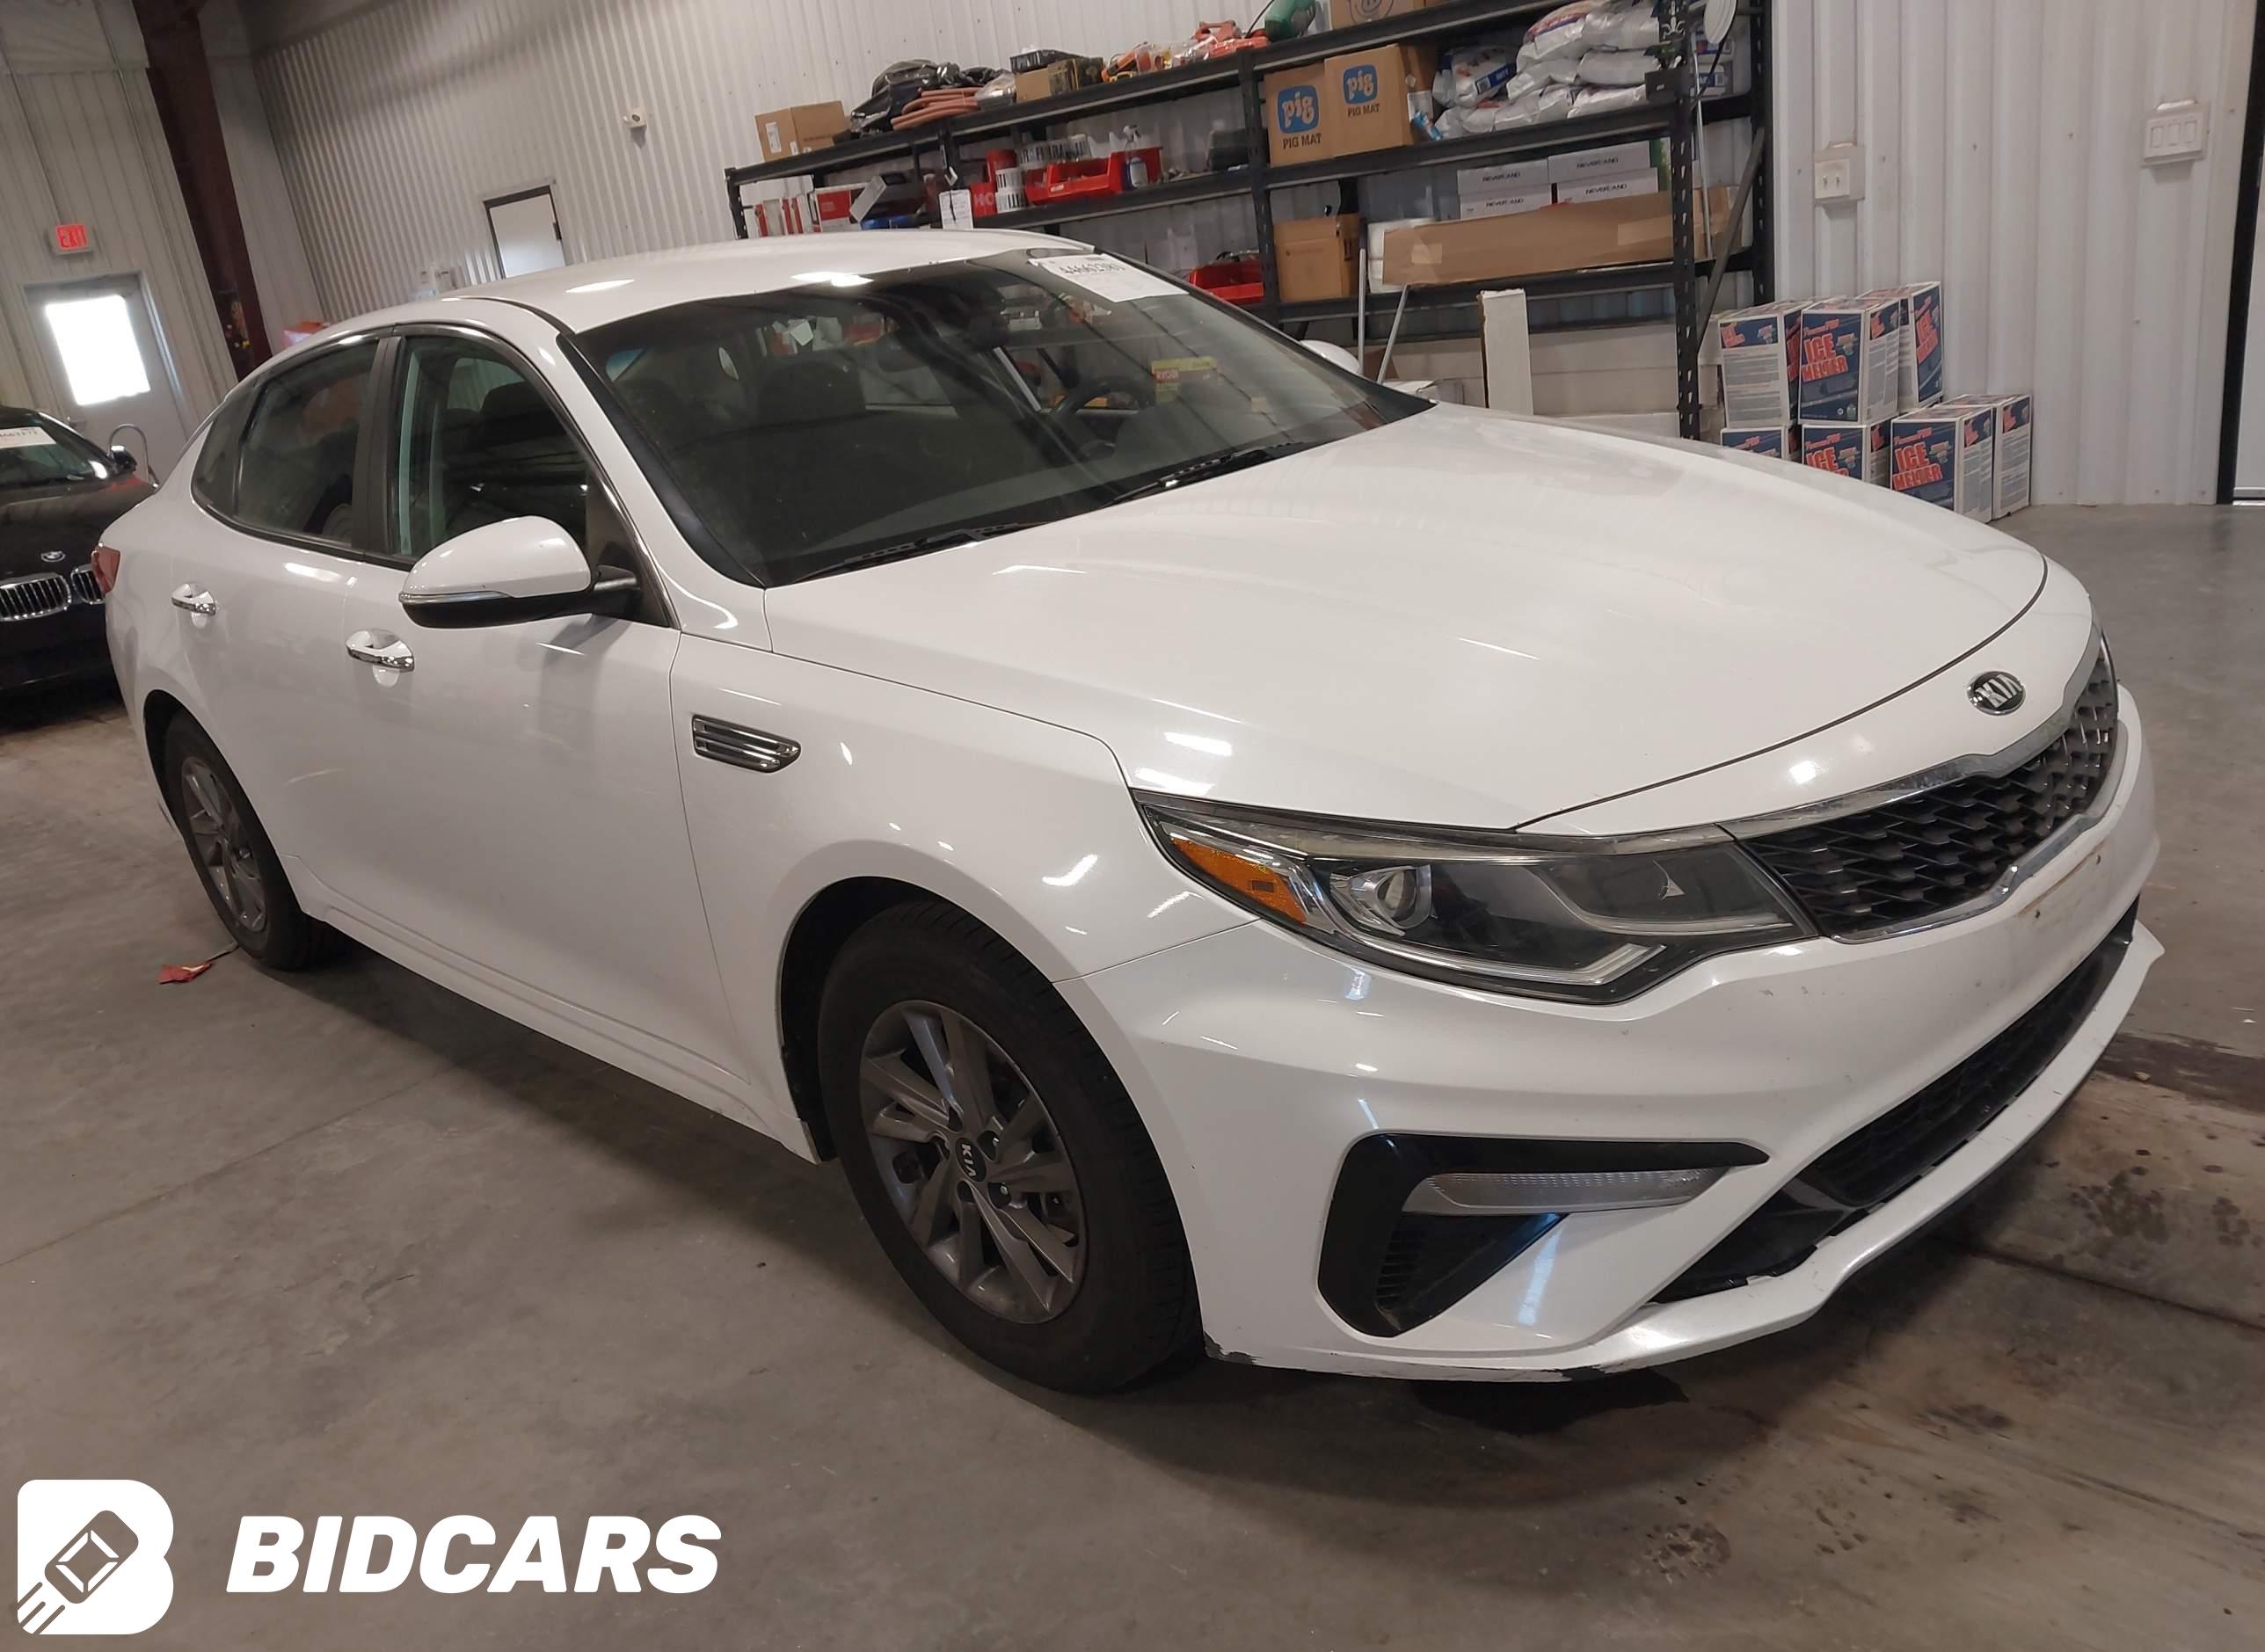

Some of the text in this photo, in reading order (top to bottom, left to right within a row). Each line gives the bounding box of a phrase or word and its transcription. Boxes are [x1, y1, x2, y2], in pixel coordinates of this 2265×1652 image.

[1346, 70, 1373, 100] pig
[1282, 91, 1315, 127] pig
[1347, 104, 1380, 117] PIG MAT
[1283, 134, 1322, 149] PIG MAT
[57, 226, 89, 248] EXIT
[1803, 333, 1836, 363] ICE
[1806, 447, 1839, 472] ICE
[1895, 441, 1931, 473] ICE
[1975, 673, 2022, 708] KIA
[962, 1143, 977, 1176] KIA
